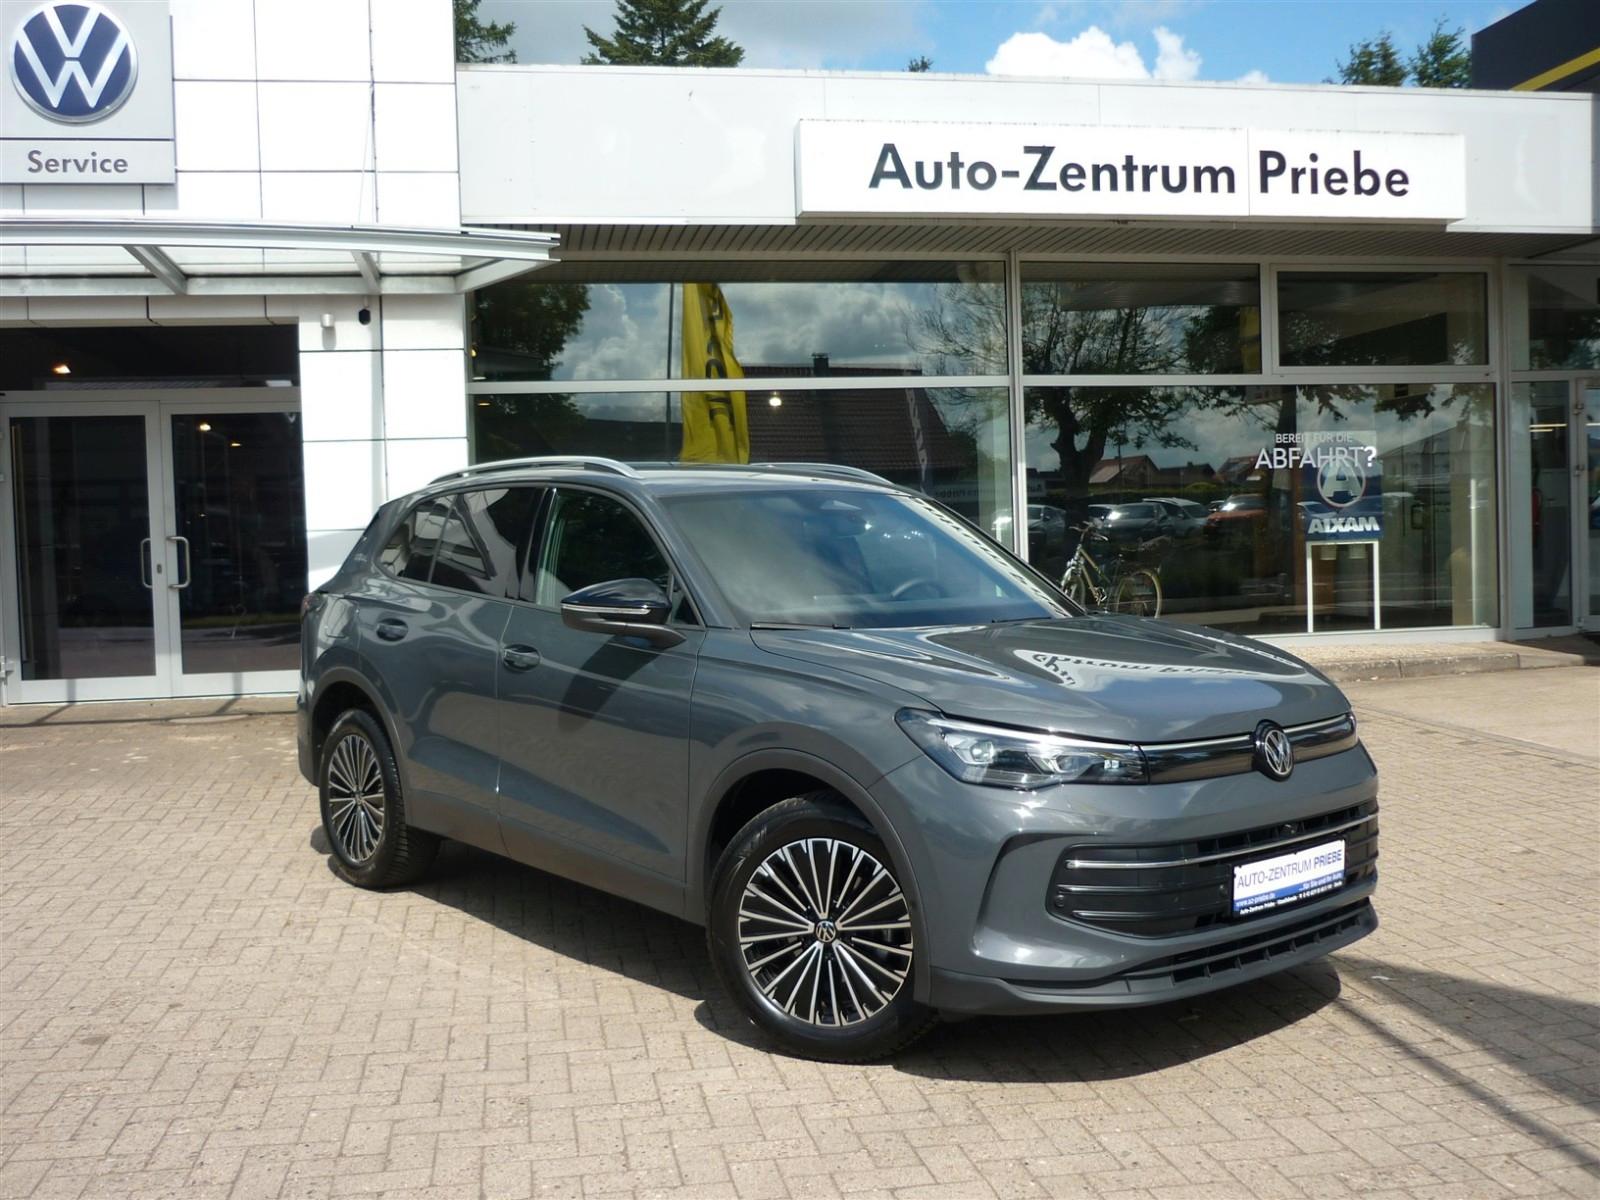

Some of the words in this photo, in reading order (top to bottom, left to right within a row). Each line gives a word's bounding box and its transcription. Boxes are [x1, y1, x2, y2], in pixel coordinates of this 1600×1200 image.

[13, 3, 134, 118] VW
[27, 149, 129, 174] Service
[868, 142, 1236, 194] Auto-Zentrum
[1257, 149, 1410, 197] Priebe
[1336, 431, 1352, 443] DIE
[1254, 445, 1377, 470] ABFAHRT?
[1308, 516, 1381, 534] AIXAM
[1237, 859, 1312, 889] AUTO-ZENTRUM
[1313, 849, 1342, 870] PRIEBE
